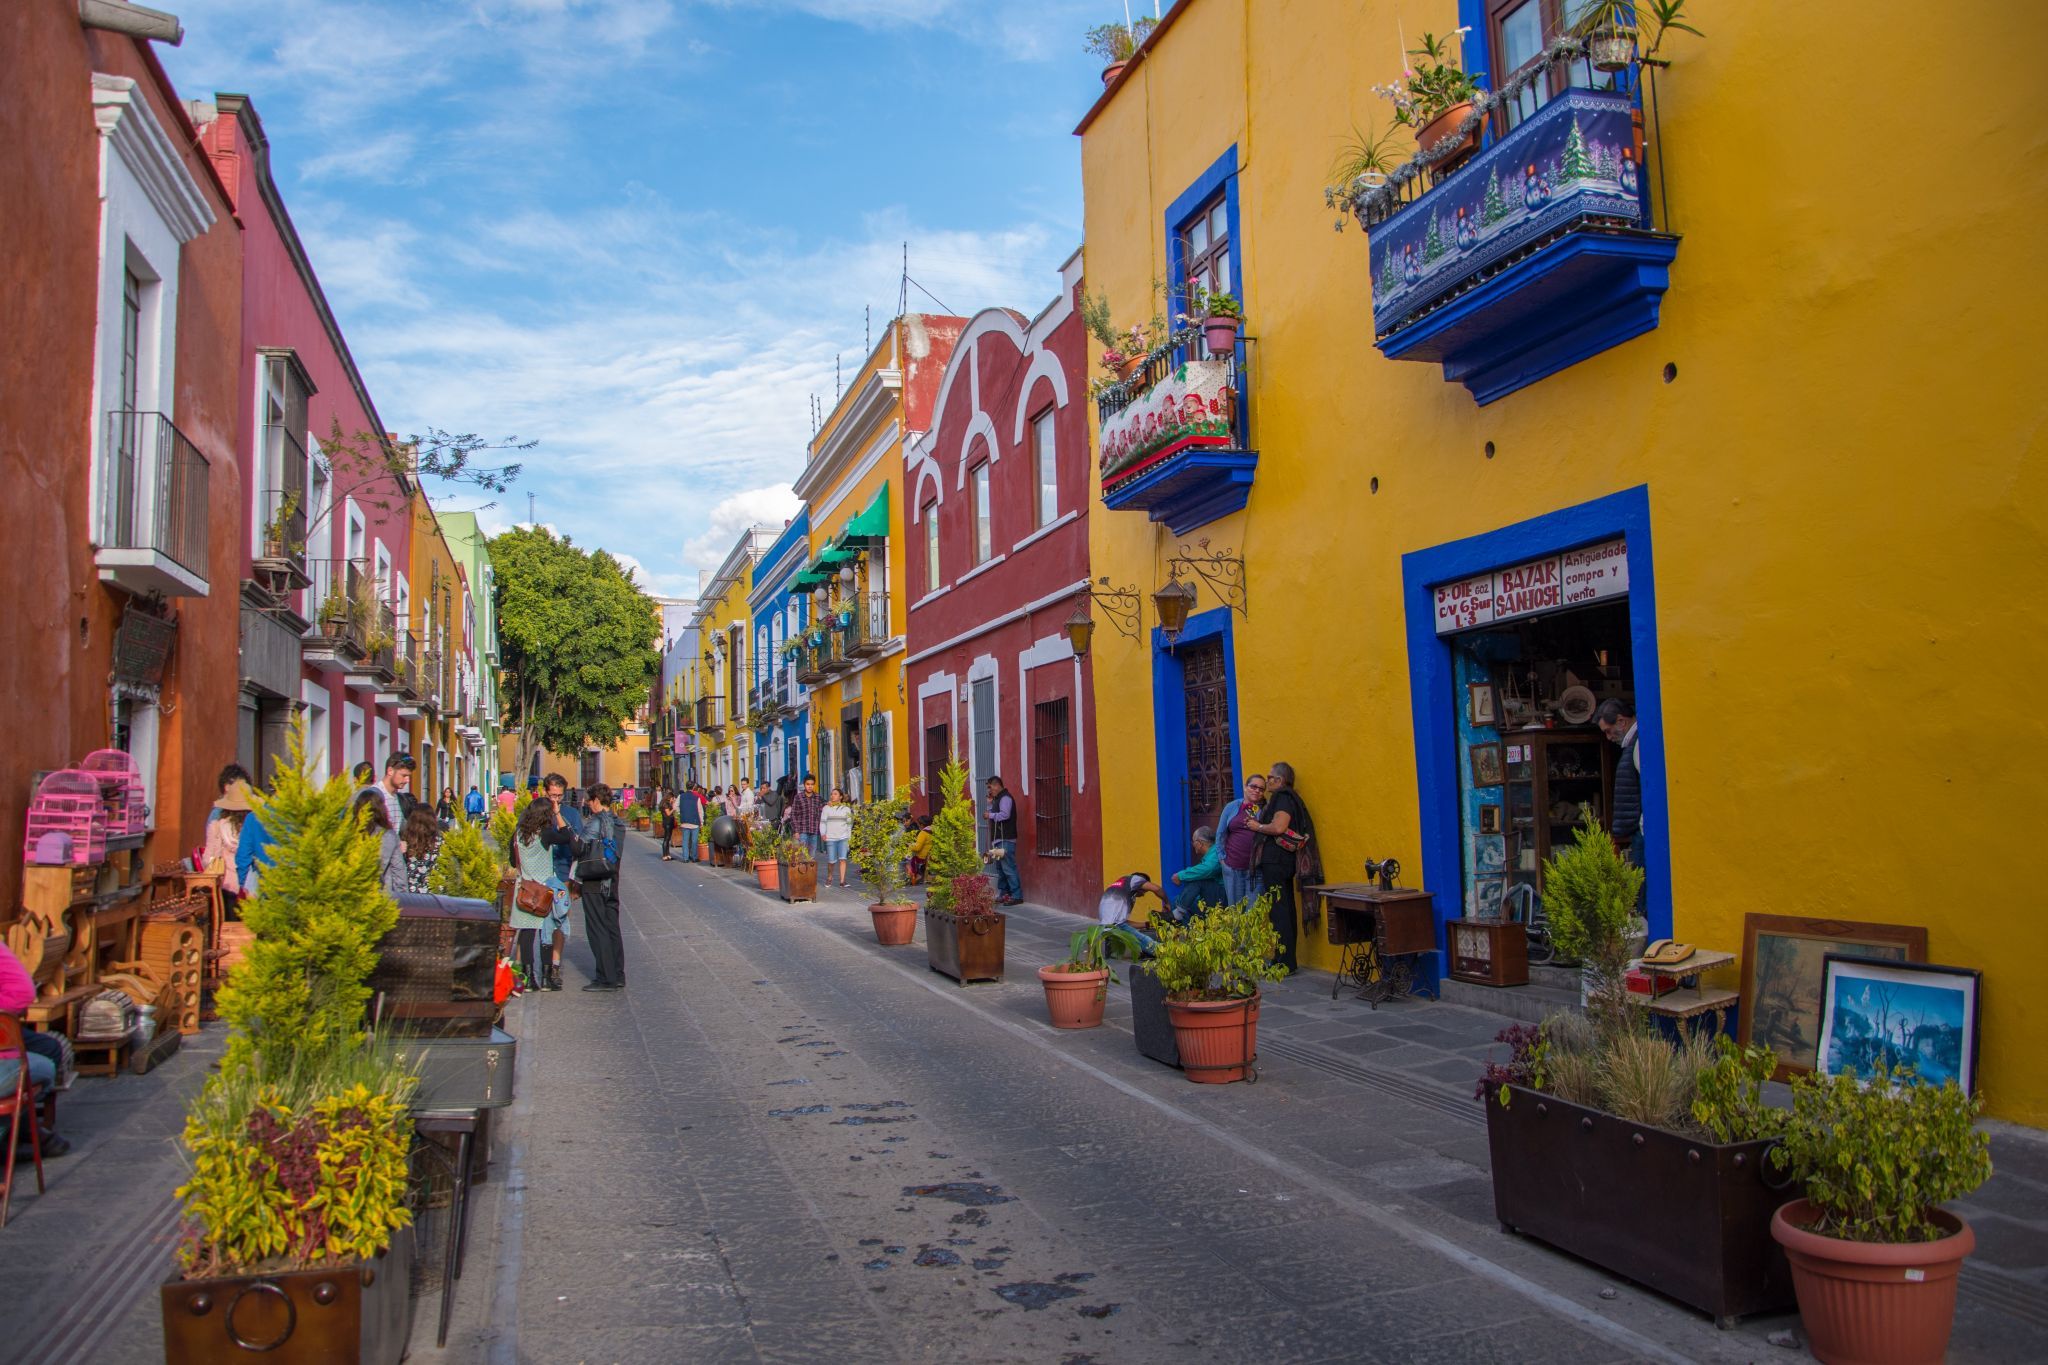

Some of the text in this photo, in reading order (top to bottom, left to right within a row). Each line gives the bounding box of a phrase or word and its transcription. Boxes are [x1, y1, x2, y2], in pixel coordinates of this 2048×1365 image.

[1565, 543, 1627, 567] Antigüedade
[1503, 560, 1558, 593] BAZAR
[1566, 569, 1604, 585] compra
[1567, 586, 1596, 602] venta
